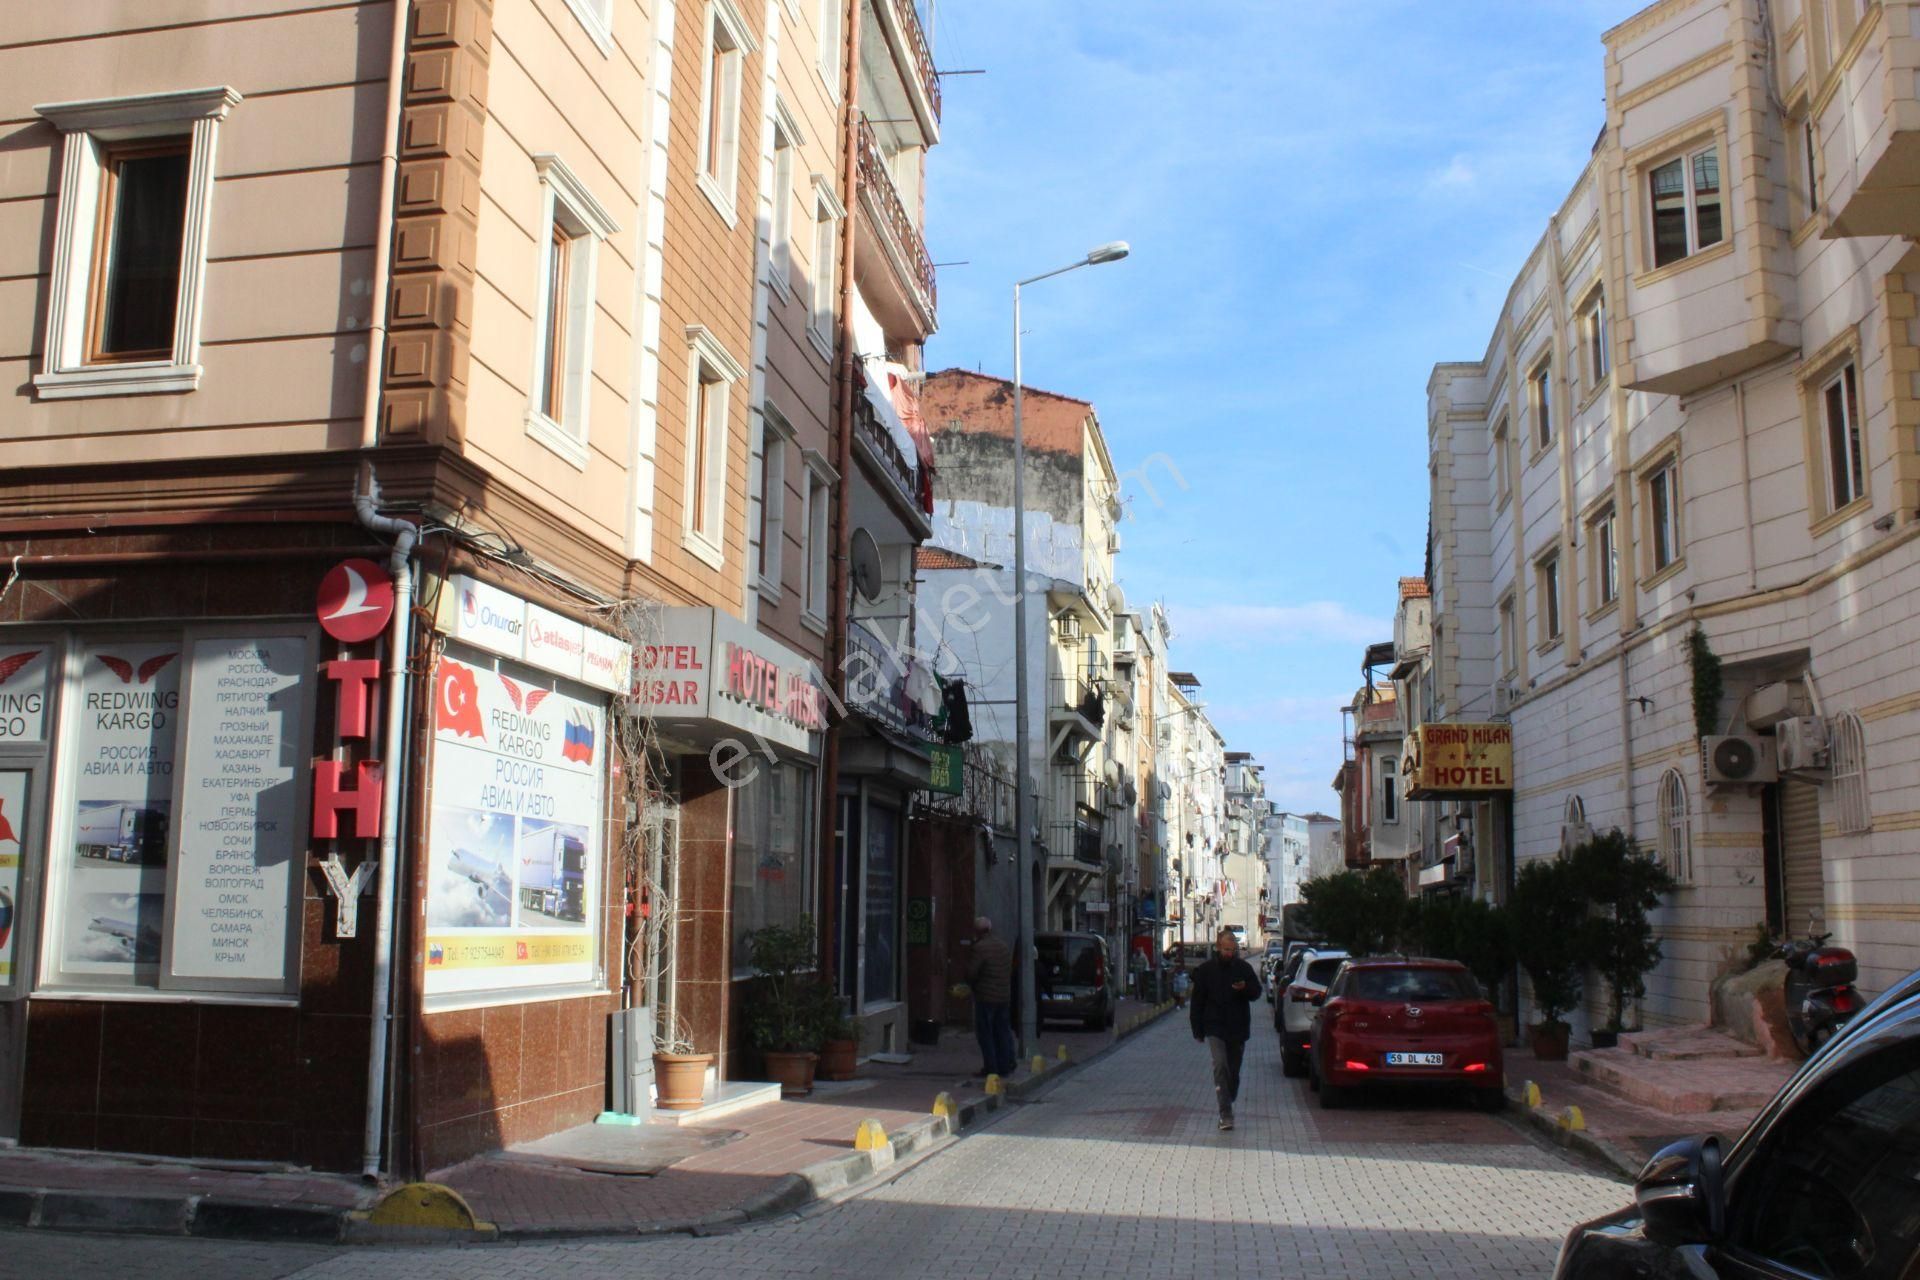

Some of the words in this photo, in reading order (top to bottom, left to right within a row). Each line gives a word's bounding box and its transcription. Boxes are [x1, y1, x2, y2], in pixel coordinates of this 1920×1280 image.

[481, 607, 522, 636] Onurair
[228, 650, 270, 660] МОСКВА
[217, 677, 279, 687] КРАСНОДАР
[728, 641, 783, 714] HOTEL
[87, 691, 178, 710] REDWING
[217, 692, 276, 702] ПЯТИГОРСК
[225, 707, 266, 716] НАЛЧИК
[96, 712, 166, 730] KARGO
[220, 720, 269, 731] ГРОЗНЫЙ
[492, 708, 551, 741] REDWING
[213, 735, 274, 745] МАХАЧКАЛЕ
[1427, 728, 1469, 745] GRAND
[499, 732, 543, 760] KARGO
[100, 746, 157, 760] РОССИЯ
[215, 749, 271, 759] ХАСАВЮРТ
[84, 762, 120, 775] АВИА
[124, 763, 133, 775] И
[137, 762, 173, 775] АВТО
[222, 764, 261, 773] КАЗАНЬ
[496, 759, 543, 788] РОССИЯ
[1434, 766, 1506, 786] HOTEL
[202, 778, 281, 788] ЕКАТЕРИНБУРГ
[230, 793, 250, 801] УФА
[481, 784, 512, 811] АВИА
[516, 791, 525, 812] И
[527, 793, 555, 817] АВТО
[221, 807, 256, 817] ПЕРМЬ
[199, 821, 278, 832] НОВОСИБИРСК
[223, 836, 252, 845] СОЧИ
[209, 864, 261, 875] ВОРОНЕЖ
[205, 878, 264, 889] ВОЛГОГРАД
[218, 894, 248, 904] ОМСК
[201, 909, 263, 919] ЧЕЛЯБИНСК
[210, 923, 252, 933] САМАРА
[212, 937, 249, 948] МИНСК
[215, 952, 245, 962] КРЫМ
[1391, 1054, 1402, 1063] 59
[1408, 1055, 1419, 1063] DL
